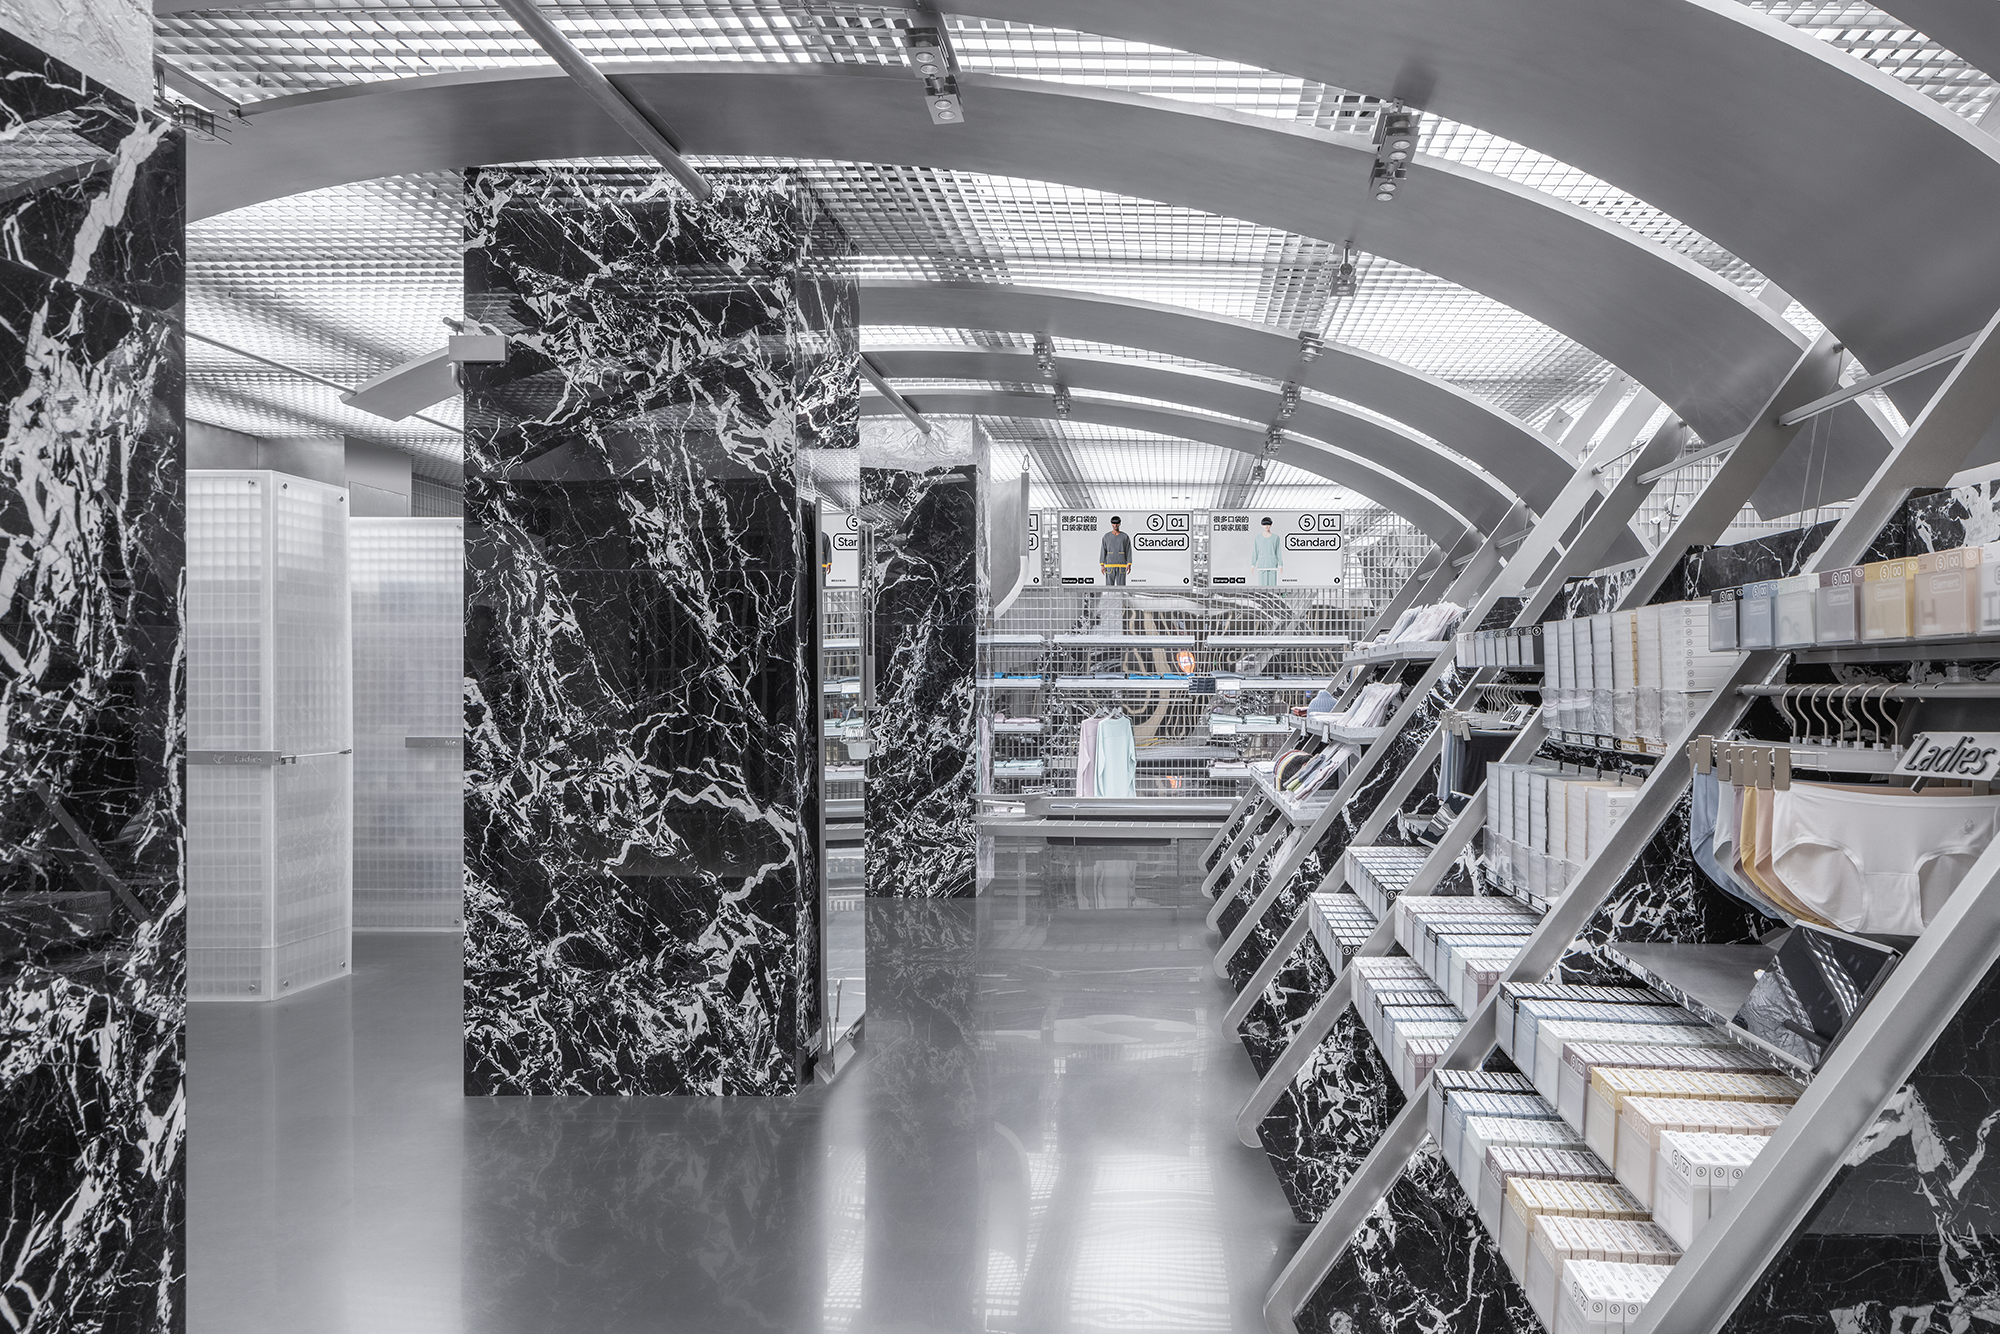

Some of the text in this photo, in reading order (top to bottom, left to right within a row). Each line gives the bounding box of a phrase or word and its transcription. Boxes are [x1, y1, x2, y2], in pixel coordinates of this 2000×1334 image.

[1170, 518, 1184, 528] 01
[1322, 518, 1336, 528] 01
[1138, 537, 1185, 547] Standard
[1289, 537, 1336, 547] Standard
[1932, 577, 1960, 590] Element
[234, 753, 262, 763] Ladies
[1904, 735, 1997, 775] Ladies
